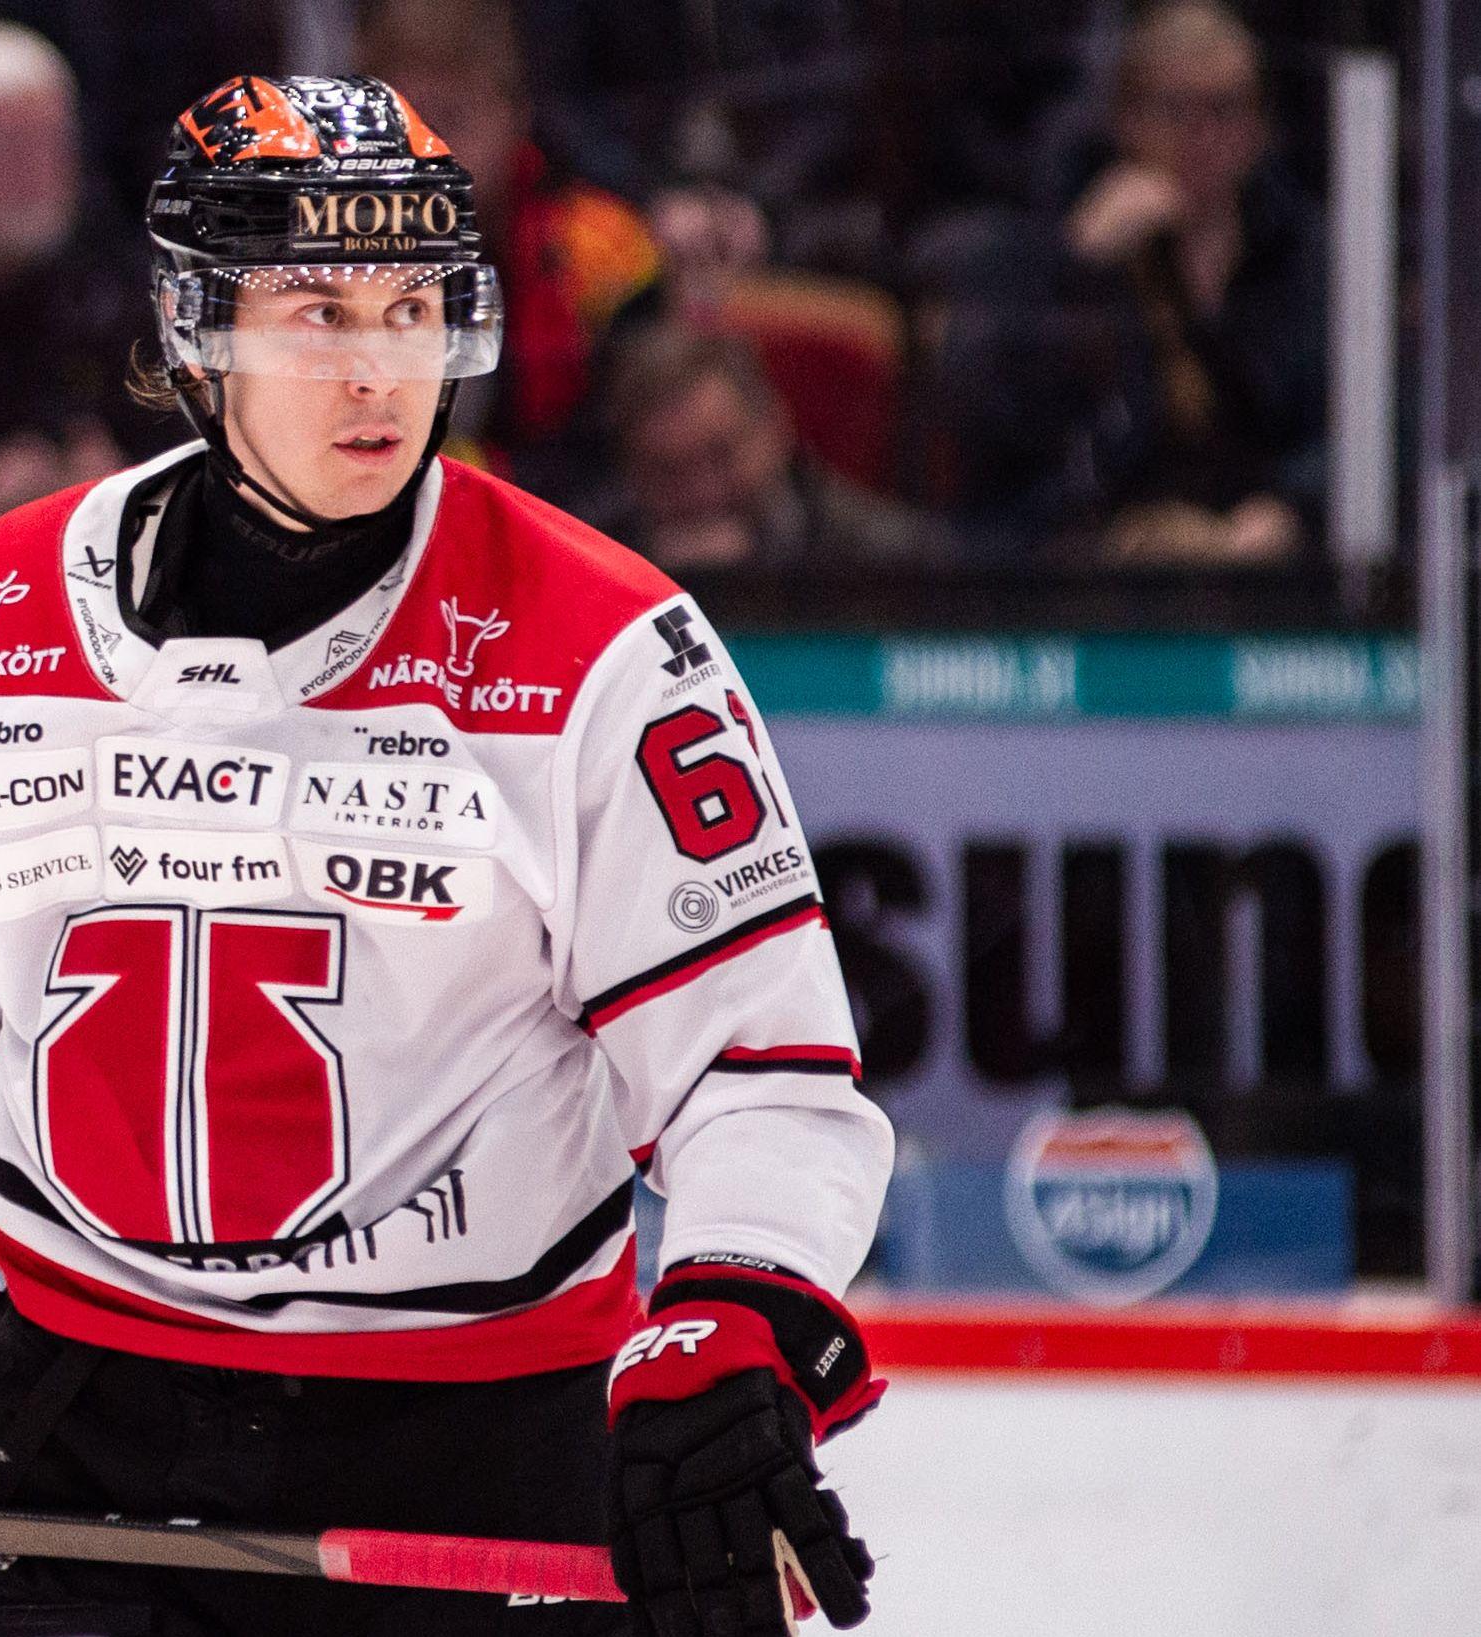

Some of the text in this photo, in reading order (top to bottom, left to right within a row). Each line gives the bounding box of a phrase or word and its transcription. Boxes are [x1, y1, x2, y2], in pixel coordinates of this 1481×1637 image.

[294, 193, 458, 237] MOFO
[344, 237, 418, 251] BOSTAD
[300, 607, 391, 696] BYGGPRODUKTION
[331, 644, 348, 658] SL
[177, 663, 241, 684] SHL
[470, 677, 563, 714] KÖTT
[114, 752, 274, 806] EXACT
[303, 776, 488, 821] NASTA
[335, 812, 445, 831] INTERIÖR
[7, 854, 93, 889] SERVICE
[158, 853, 281, 882] four fm
[326, 854, 458, 904] OBK
[714, 846, 805, 897] VIRKES
[815, 1337, 846, 1378] LEINO
